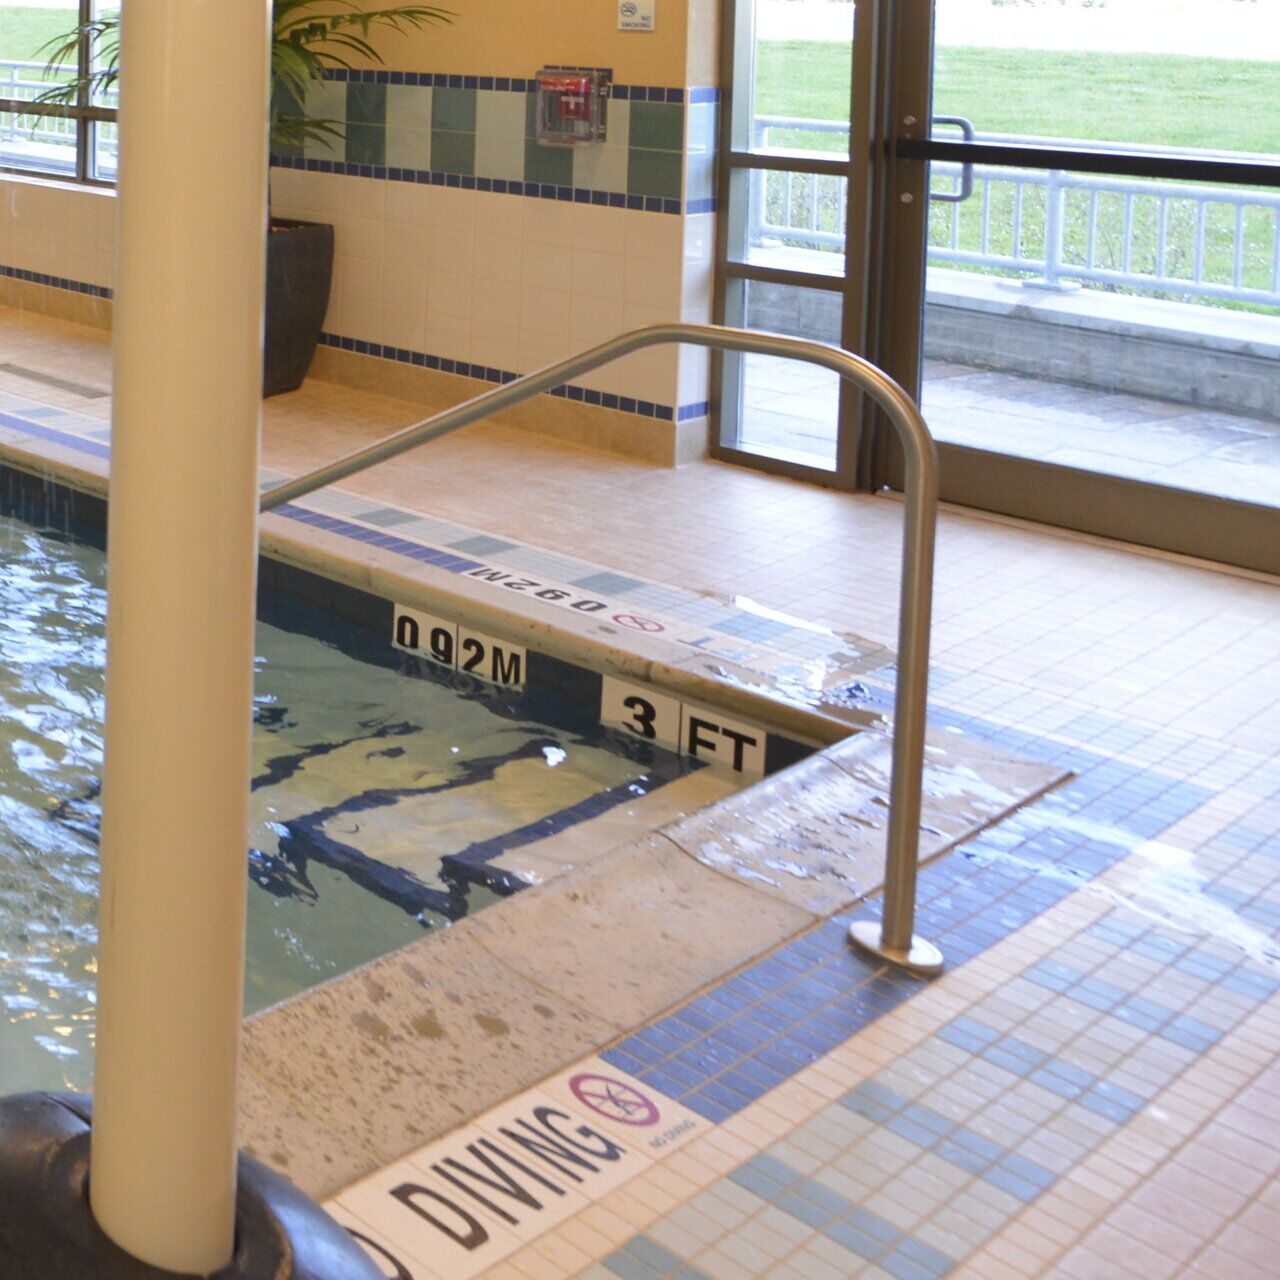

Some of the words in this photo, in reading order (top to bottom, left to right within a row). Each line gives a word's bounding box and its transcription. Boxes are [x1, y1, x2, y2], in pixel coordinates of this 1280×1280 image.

[621, 695, 657, 740] 3
[688, 715, 758, 773] FT
[389, 1106, 627, 1251] DIVING
